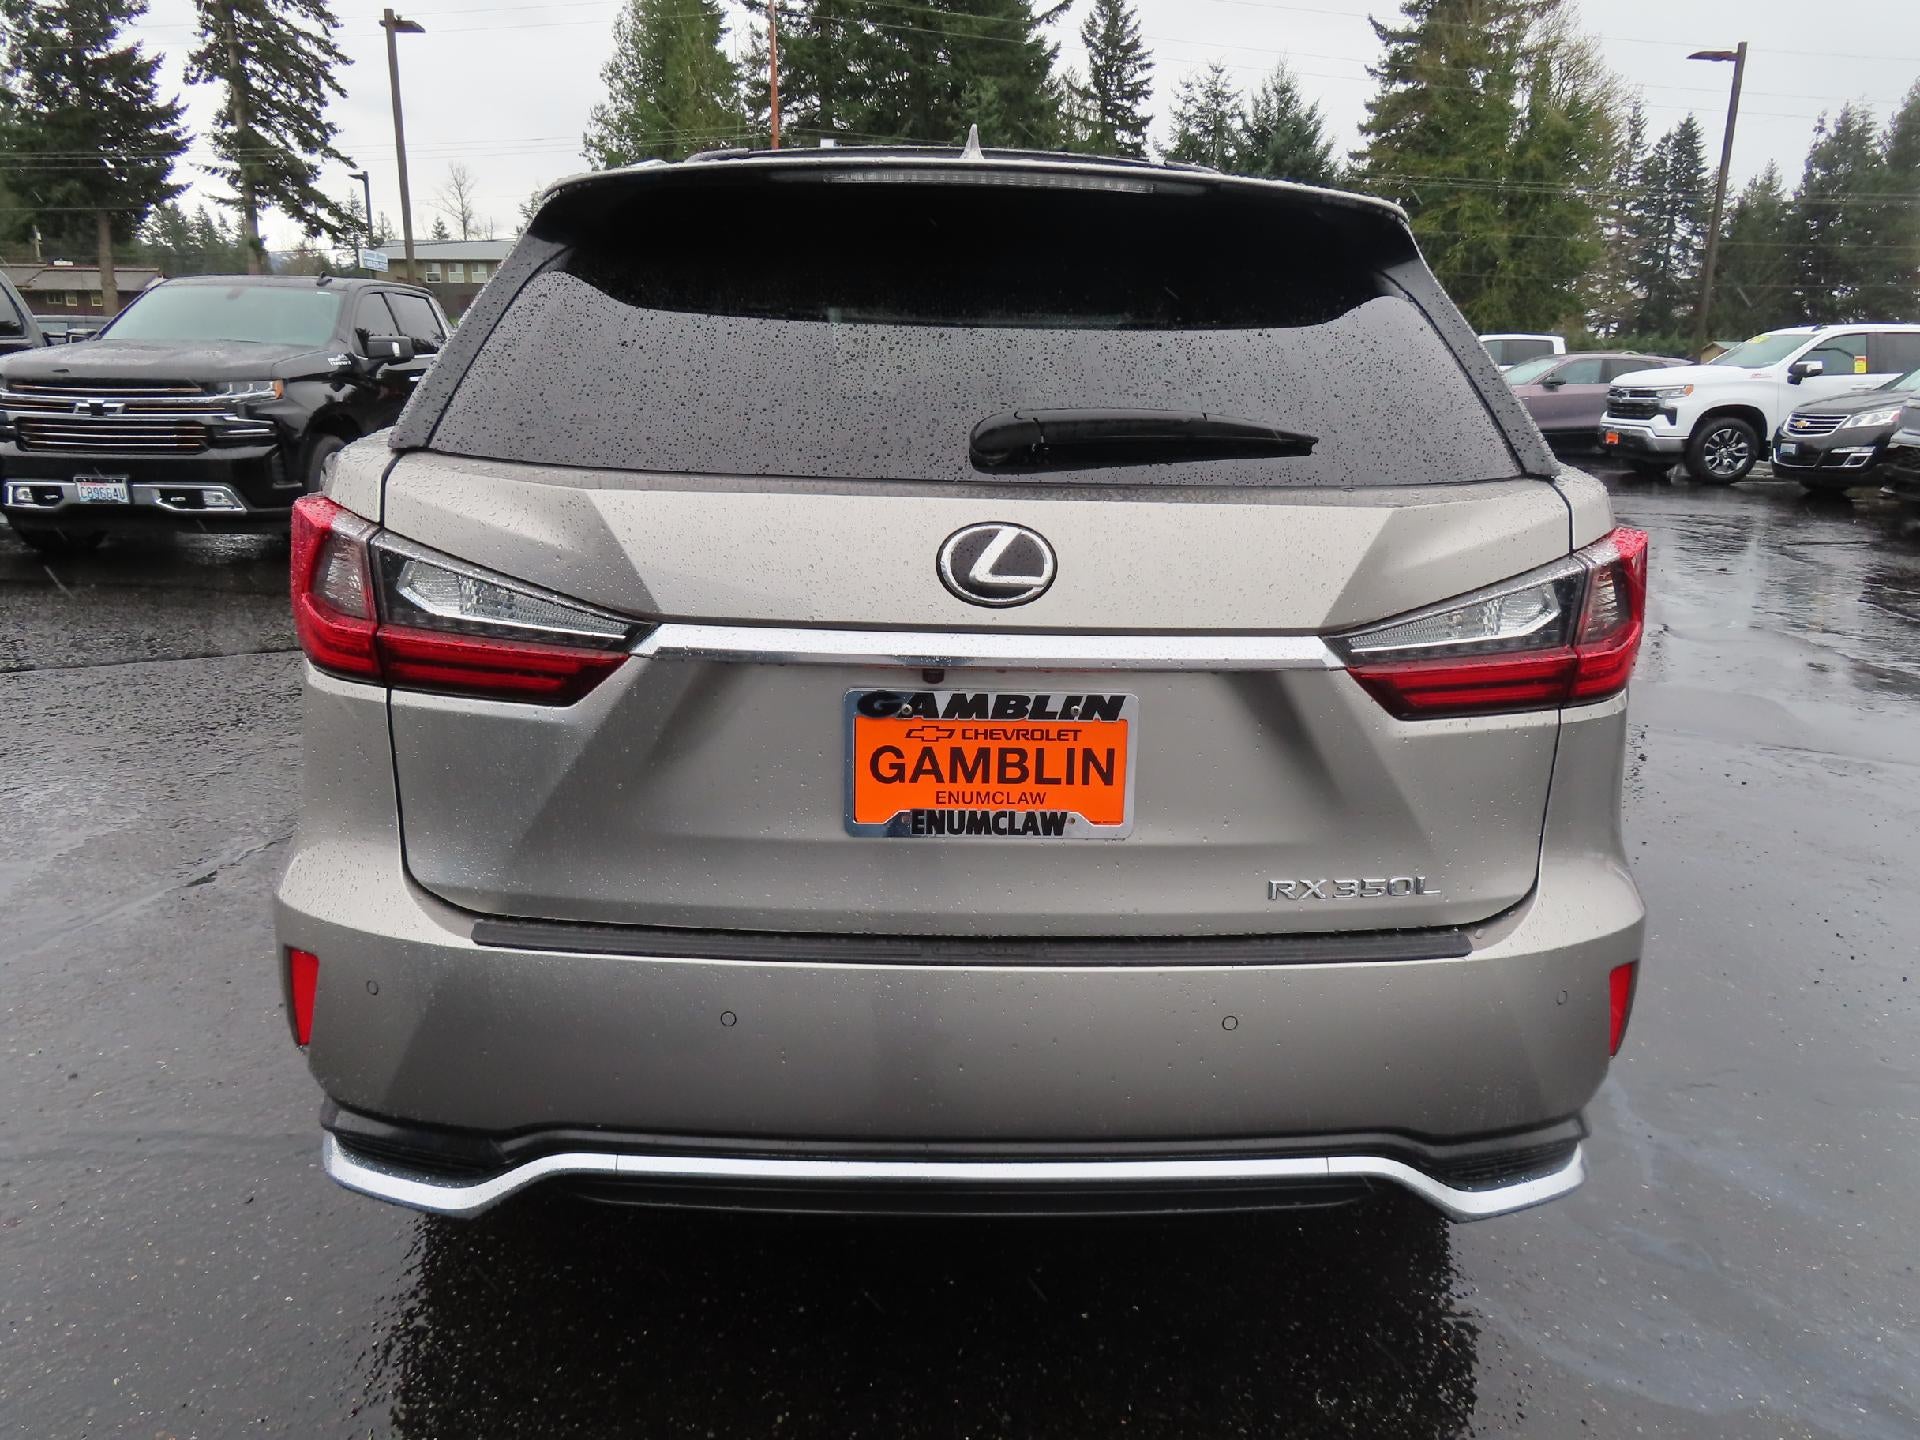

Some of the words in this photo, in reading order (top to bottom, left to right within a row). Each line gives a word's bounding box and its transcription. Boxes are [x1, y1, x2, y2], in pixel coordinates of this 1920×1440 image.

[857, 690, 1126, 720] GAMBLIN
[961, 728, 1082, 741] CHEVROLET
[869, 745, 1115, 786] GAMBLIN
[935, 790, 1047, 805] ENUMCLAW
[911, 809, 1068, 836] ENUMCLAW
[1268, 879, 1327, 900] RX
[1332, 875, 1441, 899] 350L
